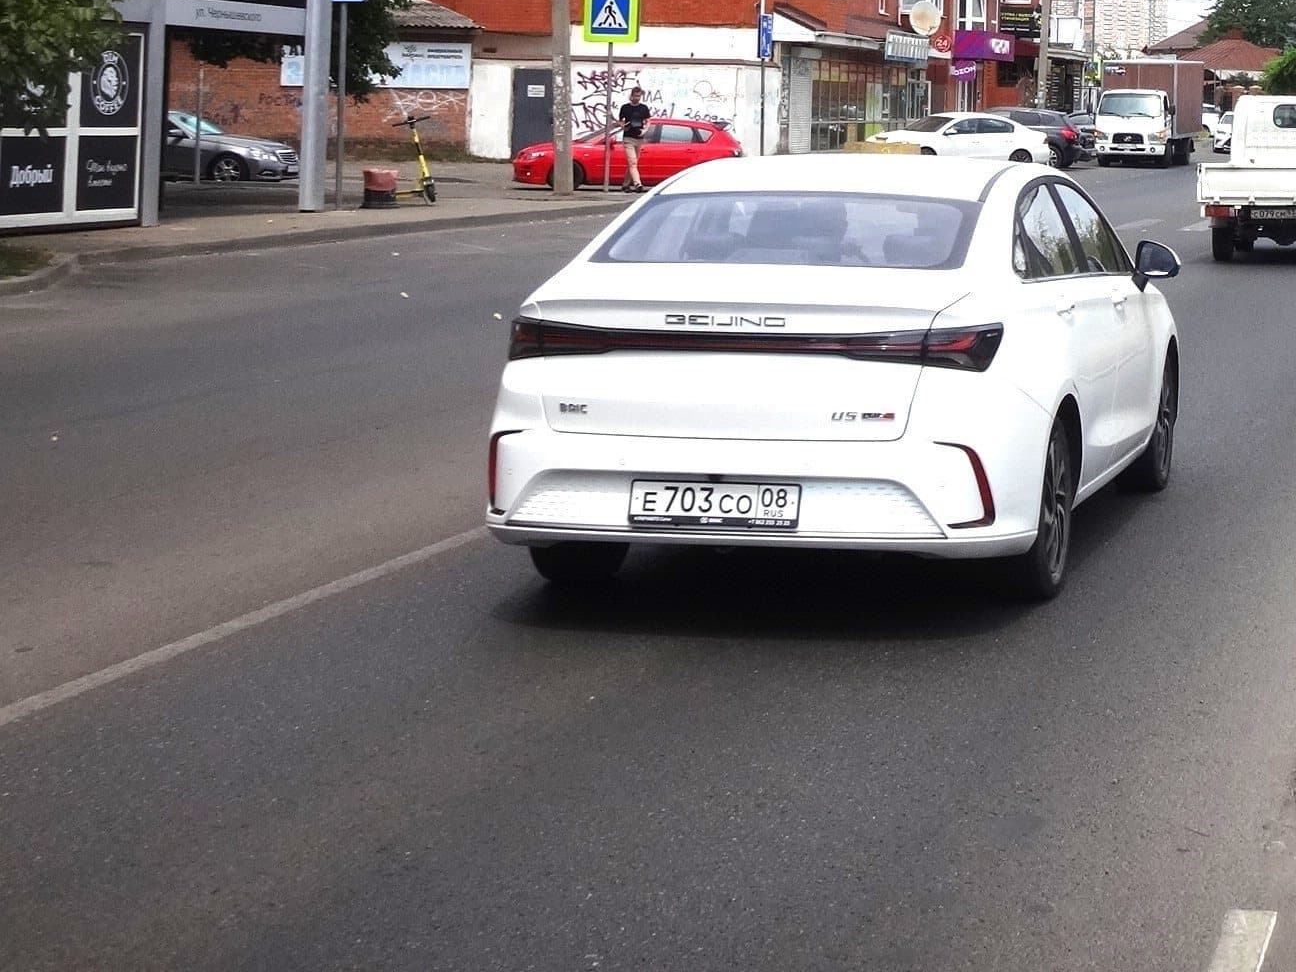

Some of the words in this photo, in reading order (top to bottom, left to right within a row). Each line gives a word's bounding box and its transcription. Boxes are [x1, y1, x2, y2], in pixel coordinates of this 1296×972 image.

[9, 163, 54, 188] Добрый
[664, 314, 786, 328] BEIJING
[761, 487, 788, 508] 08
[763, 509, 784, 518] RUS
